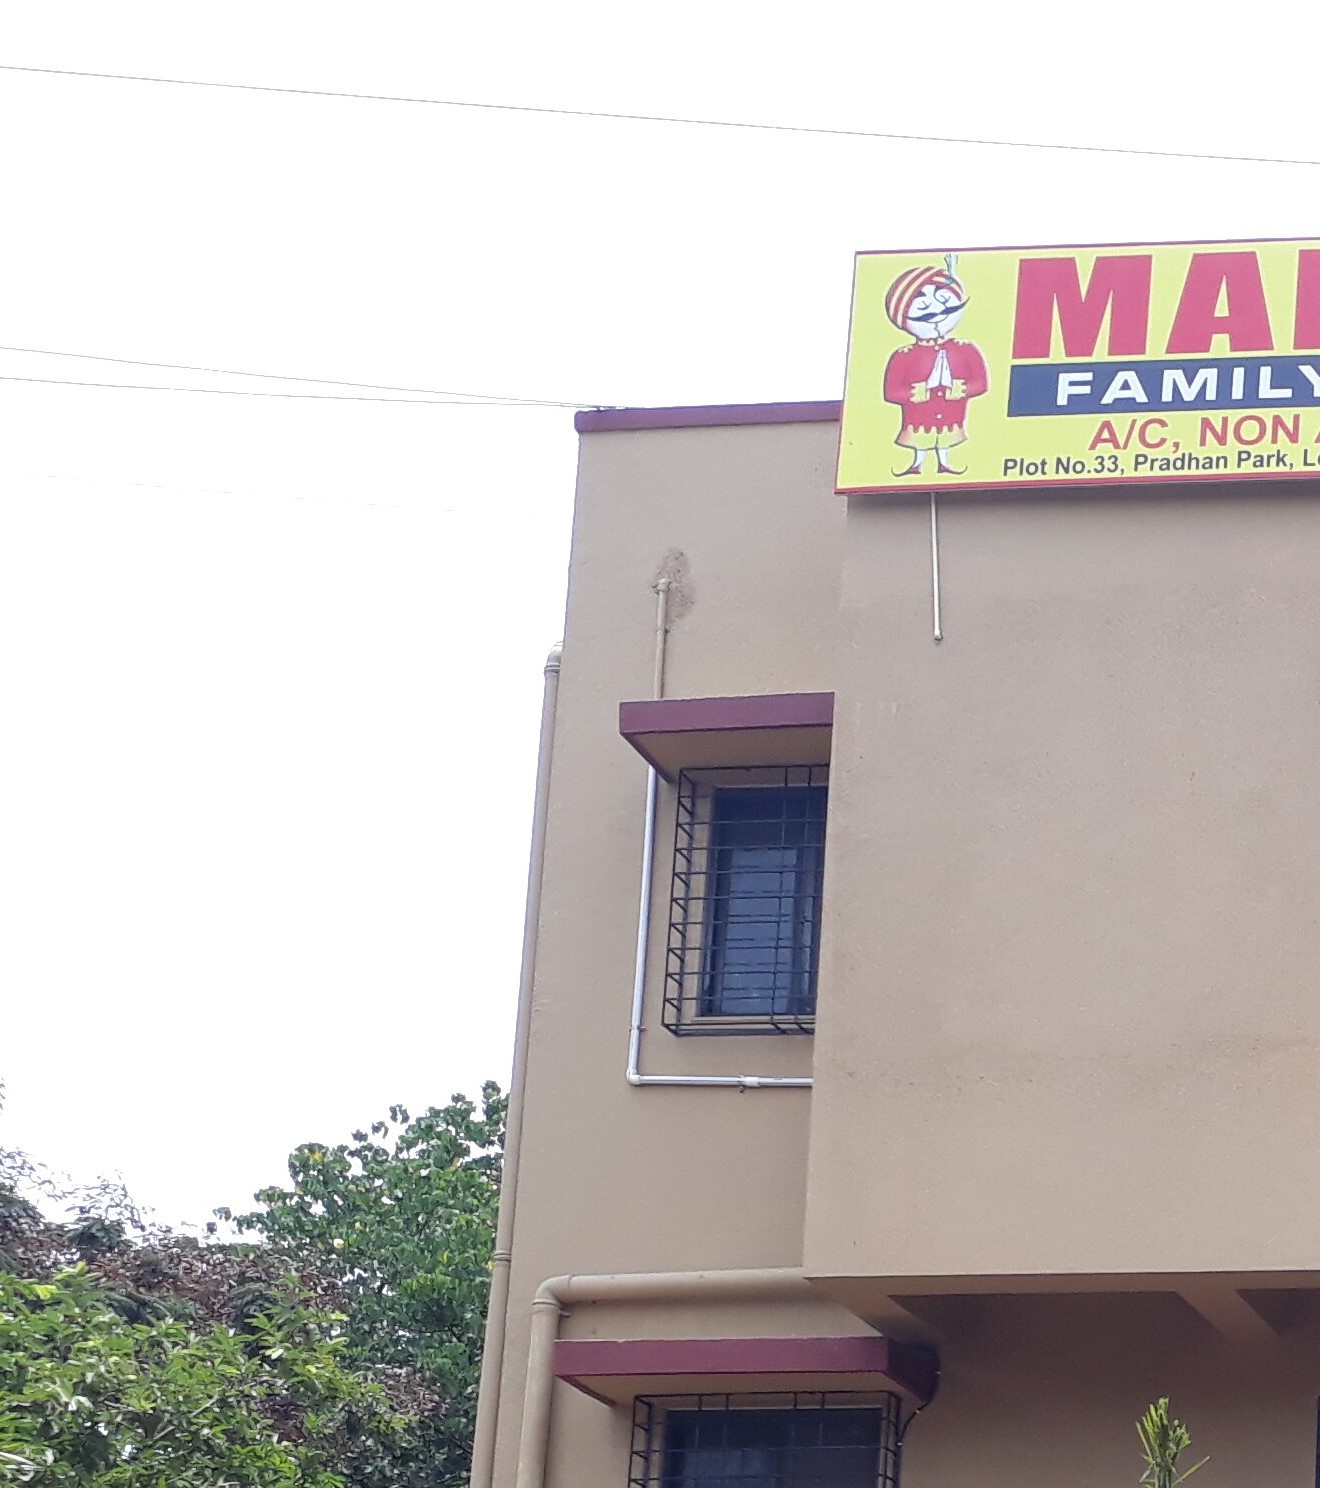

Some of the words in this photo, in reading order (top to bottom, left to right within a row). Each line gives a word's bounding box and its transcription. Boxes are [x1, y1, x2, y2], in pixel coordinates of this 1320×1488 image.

[1087, 417, 1181, 454] A/C,
[1199, 413, 1300, 447] NON
[1003, 458, 1048, 477] Plot
[1055, 456, 1125, 475] No.33,
[1133, 452, 1228, 472] Pradhan
[1237, 449, 1294, 471] Park,
